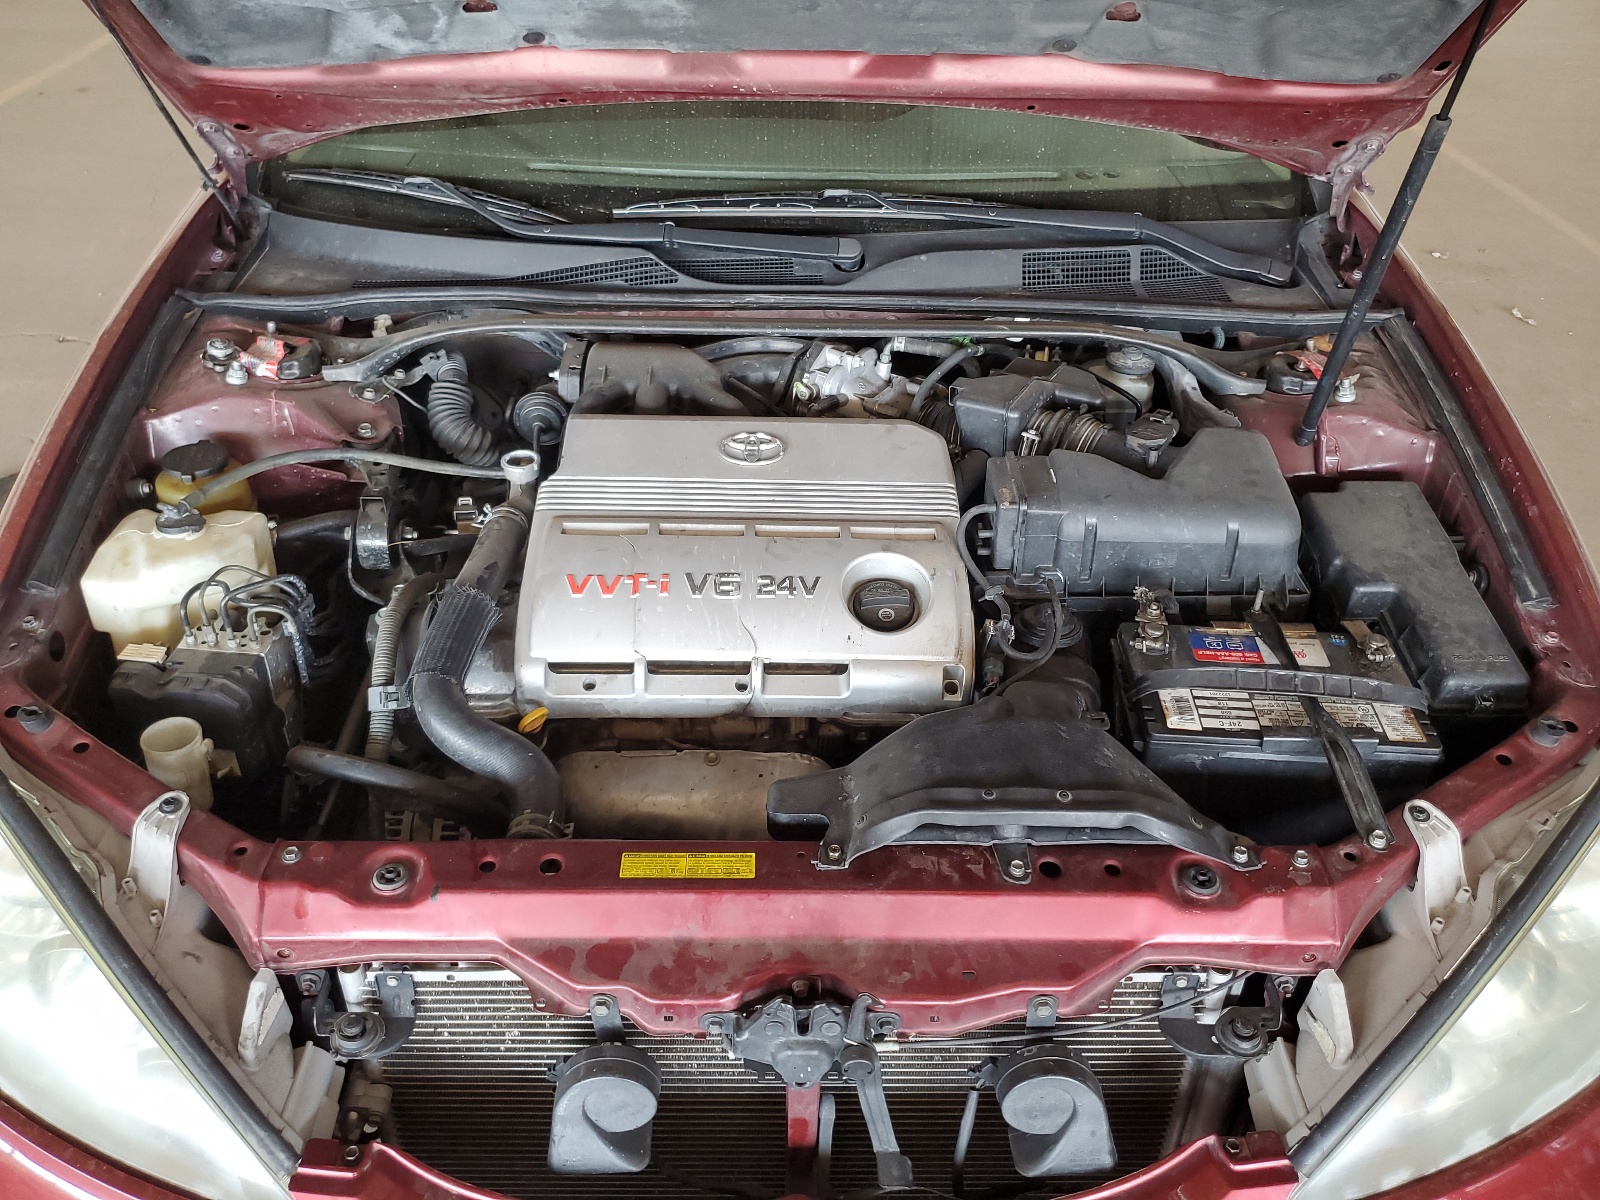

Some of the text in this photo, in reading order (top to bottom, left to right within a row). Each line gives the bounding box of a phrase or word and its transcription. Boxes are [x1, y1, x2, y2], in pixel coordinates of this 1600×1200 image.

[565, 571, 823, 599] VVT-i V6 24V
